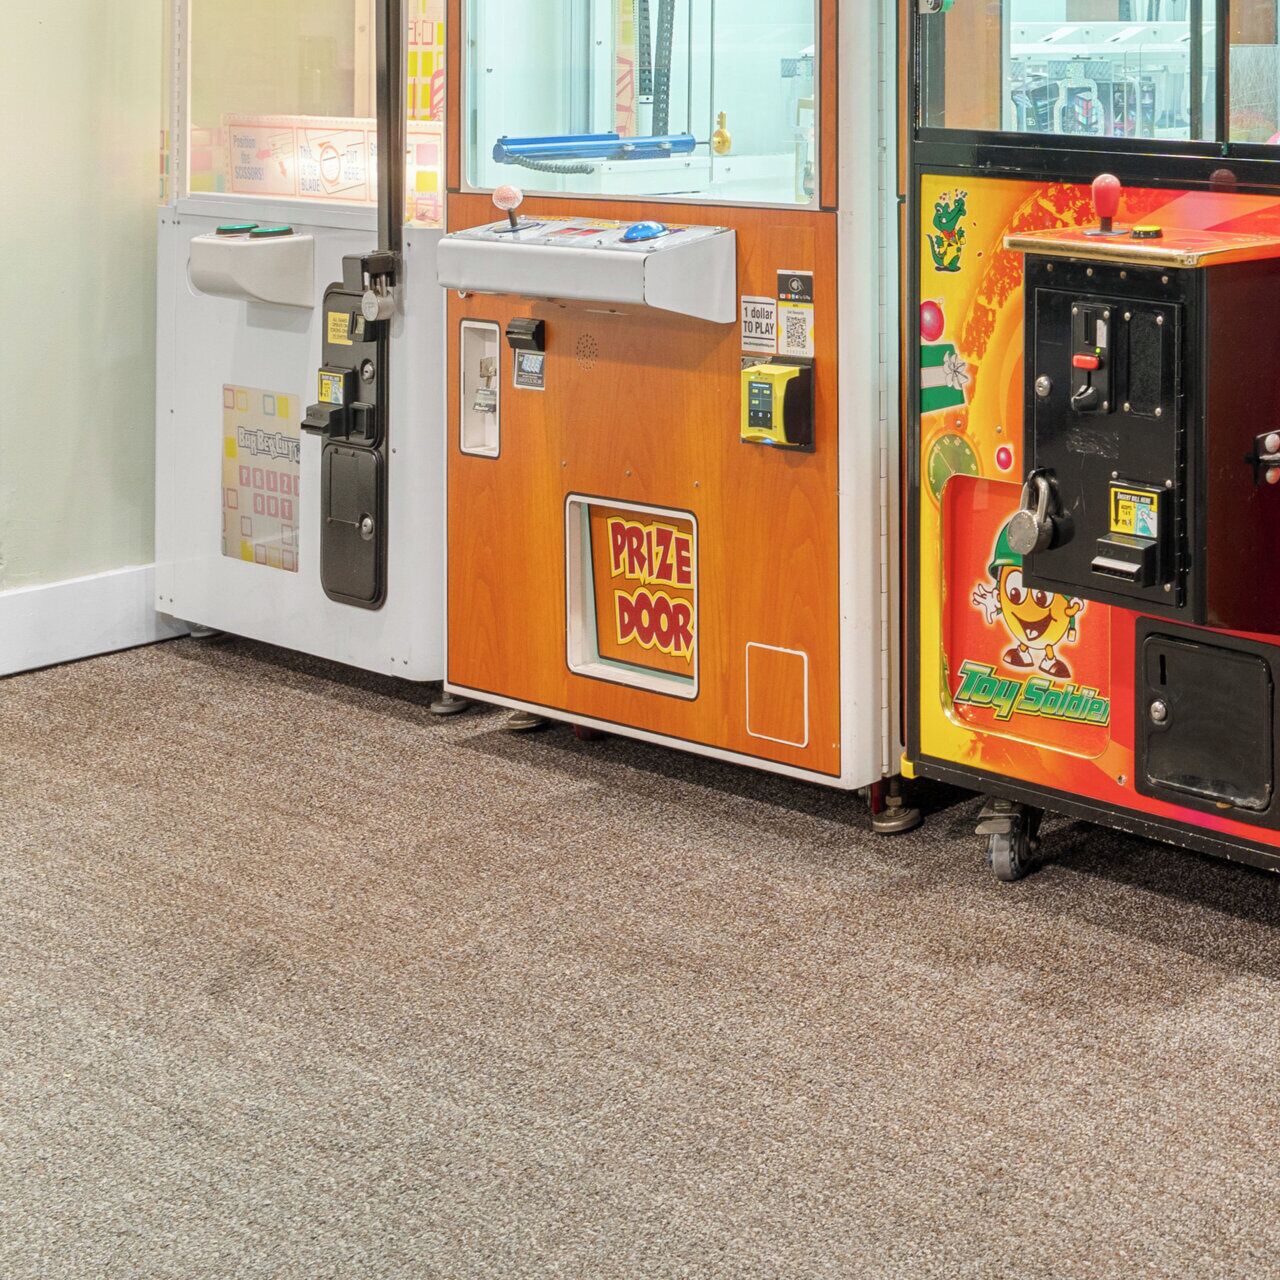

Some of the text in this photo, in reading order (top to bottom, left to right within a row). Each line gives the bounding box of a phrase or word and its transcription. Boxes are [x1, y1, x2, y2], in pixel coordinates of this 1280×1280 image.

[301, 178, 320, 192] BLADE
[744, 306, 773, 320] 1 dollar
[743, 320, 774, 335] TO PLAY
[1117, 492, 1132, 501] INSERT
[609, 519, 693, 587] PRIZE
[616, 589, 694, 654] DOOR
[954, 660, 1110, 726] Toy Soldier
